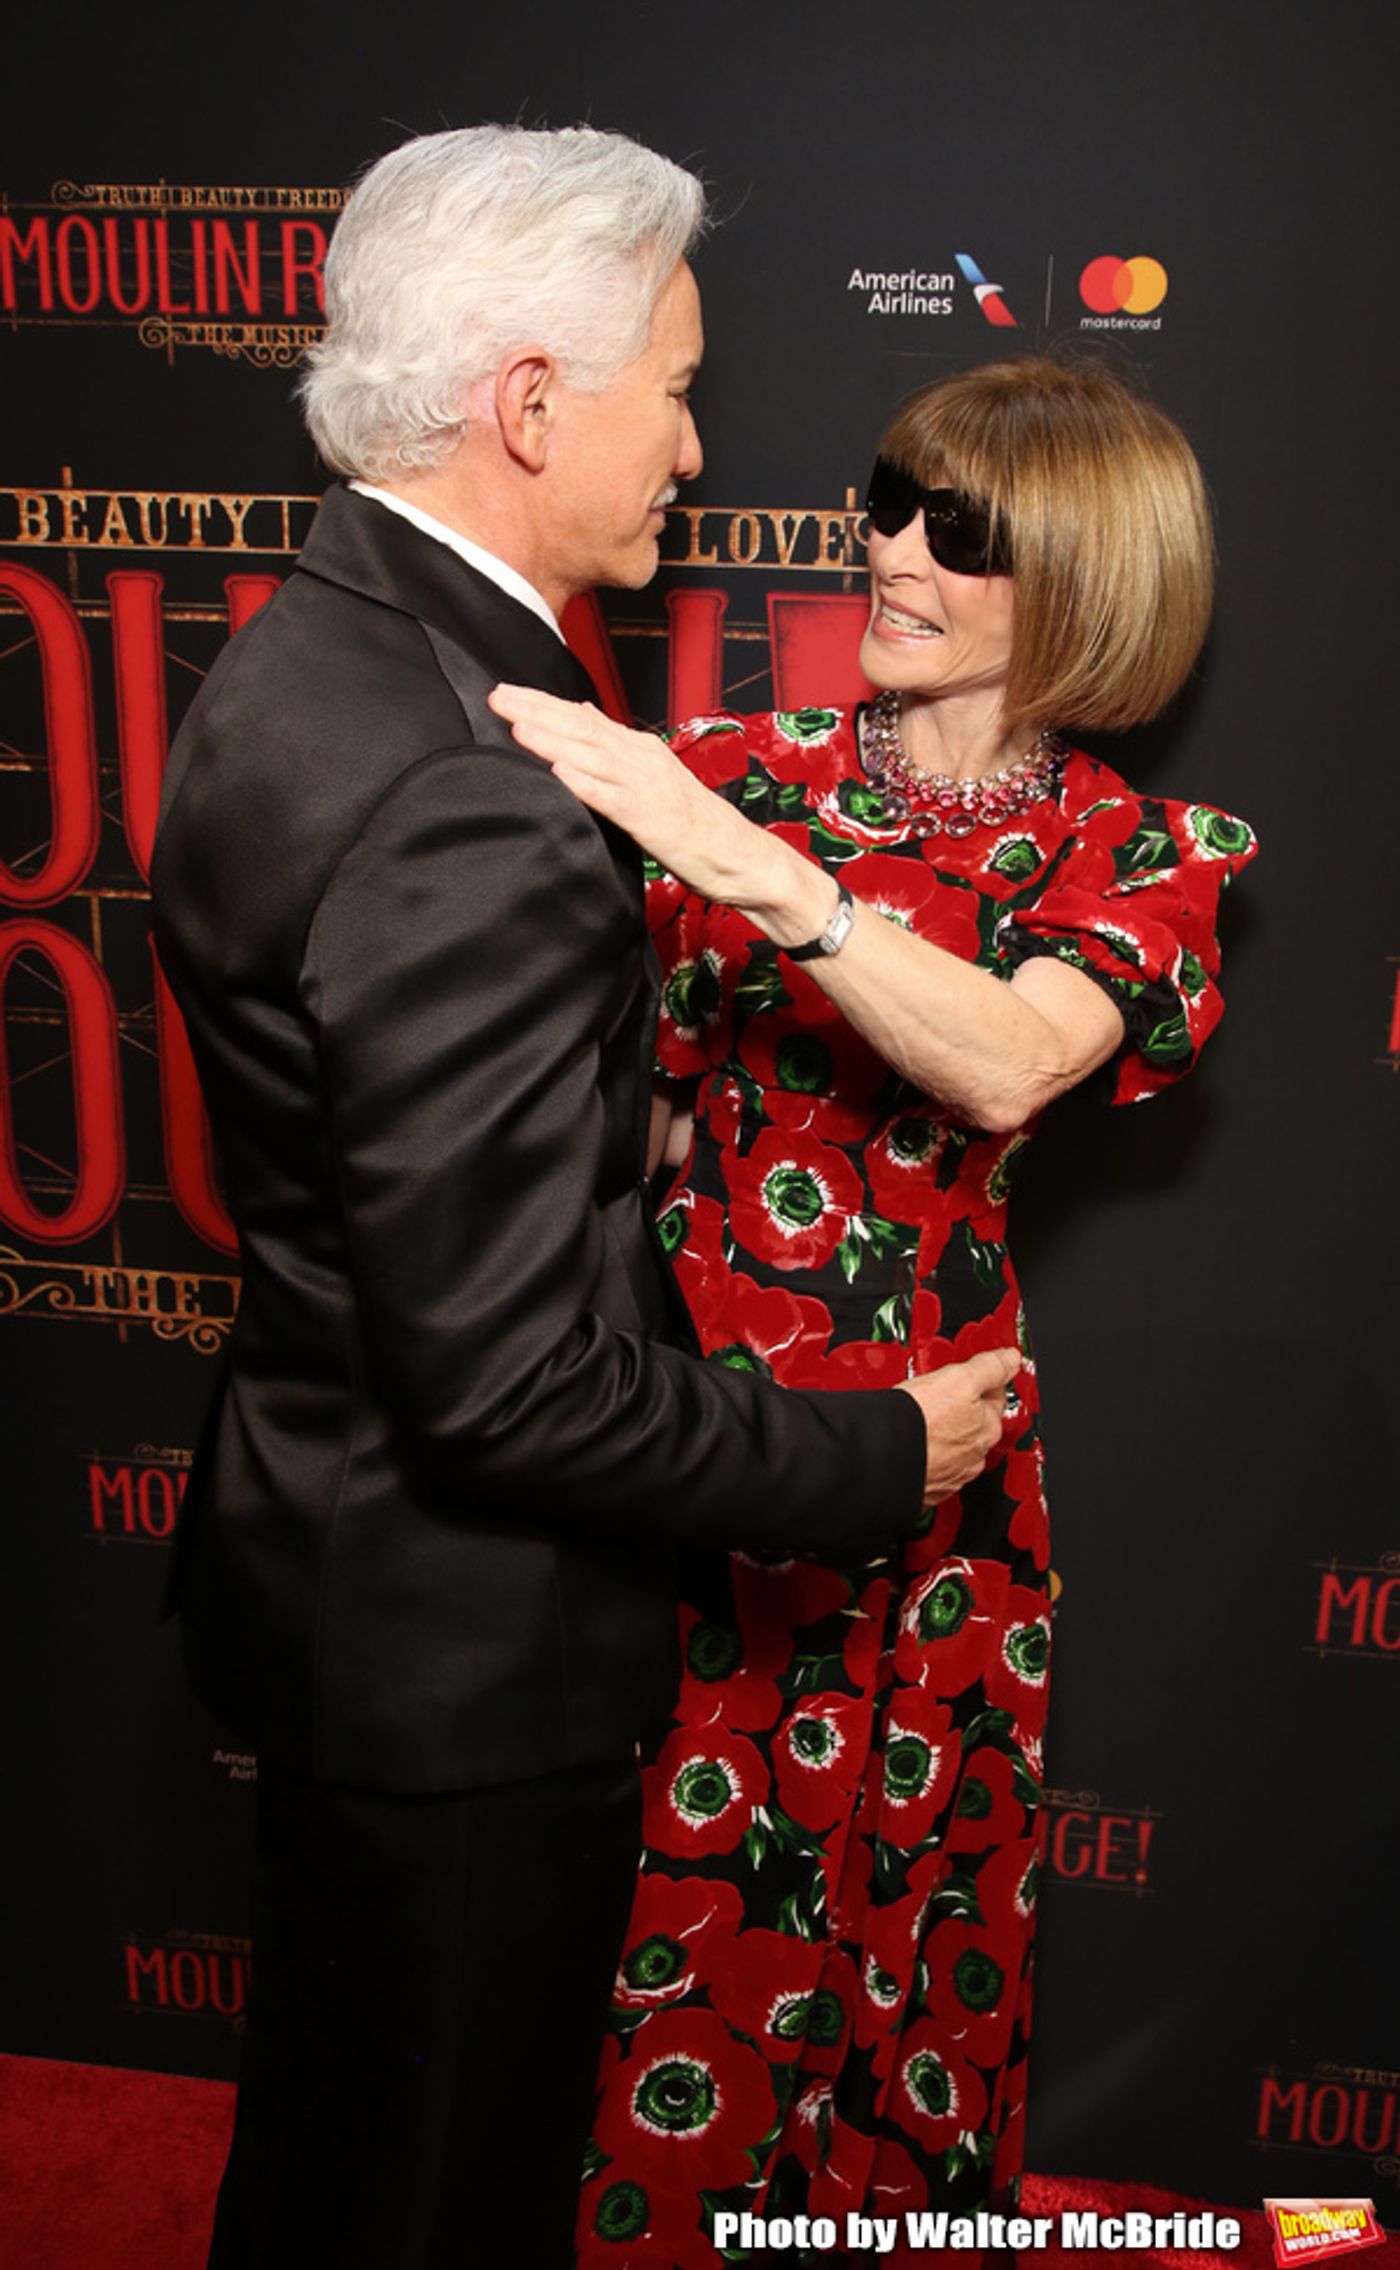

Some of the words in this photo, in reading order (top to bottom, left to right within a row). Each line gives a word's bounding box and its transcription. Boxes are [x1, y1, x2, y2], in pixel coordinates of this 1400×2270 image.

[95, 185, 161, 206] TRUTH
[180, 187, 257, 209] BEAUTY
[0, 216, 261, 316] MOULIN
[848, 269, 954, 291] American
[868, 293, 953, 315] Airlines
[188, 327, 232, 344] THE
[1080, 316, 1162, 331] mastercard
[14, 492, 254, 549] BEAUTY
[685, 511, 846, 567] LOVE
[83, 1268, 202, 1318] THE
[126, 1945, 253, 2015] MOU
